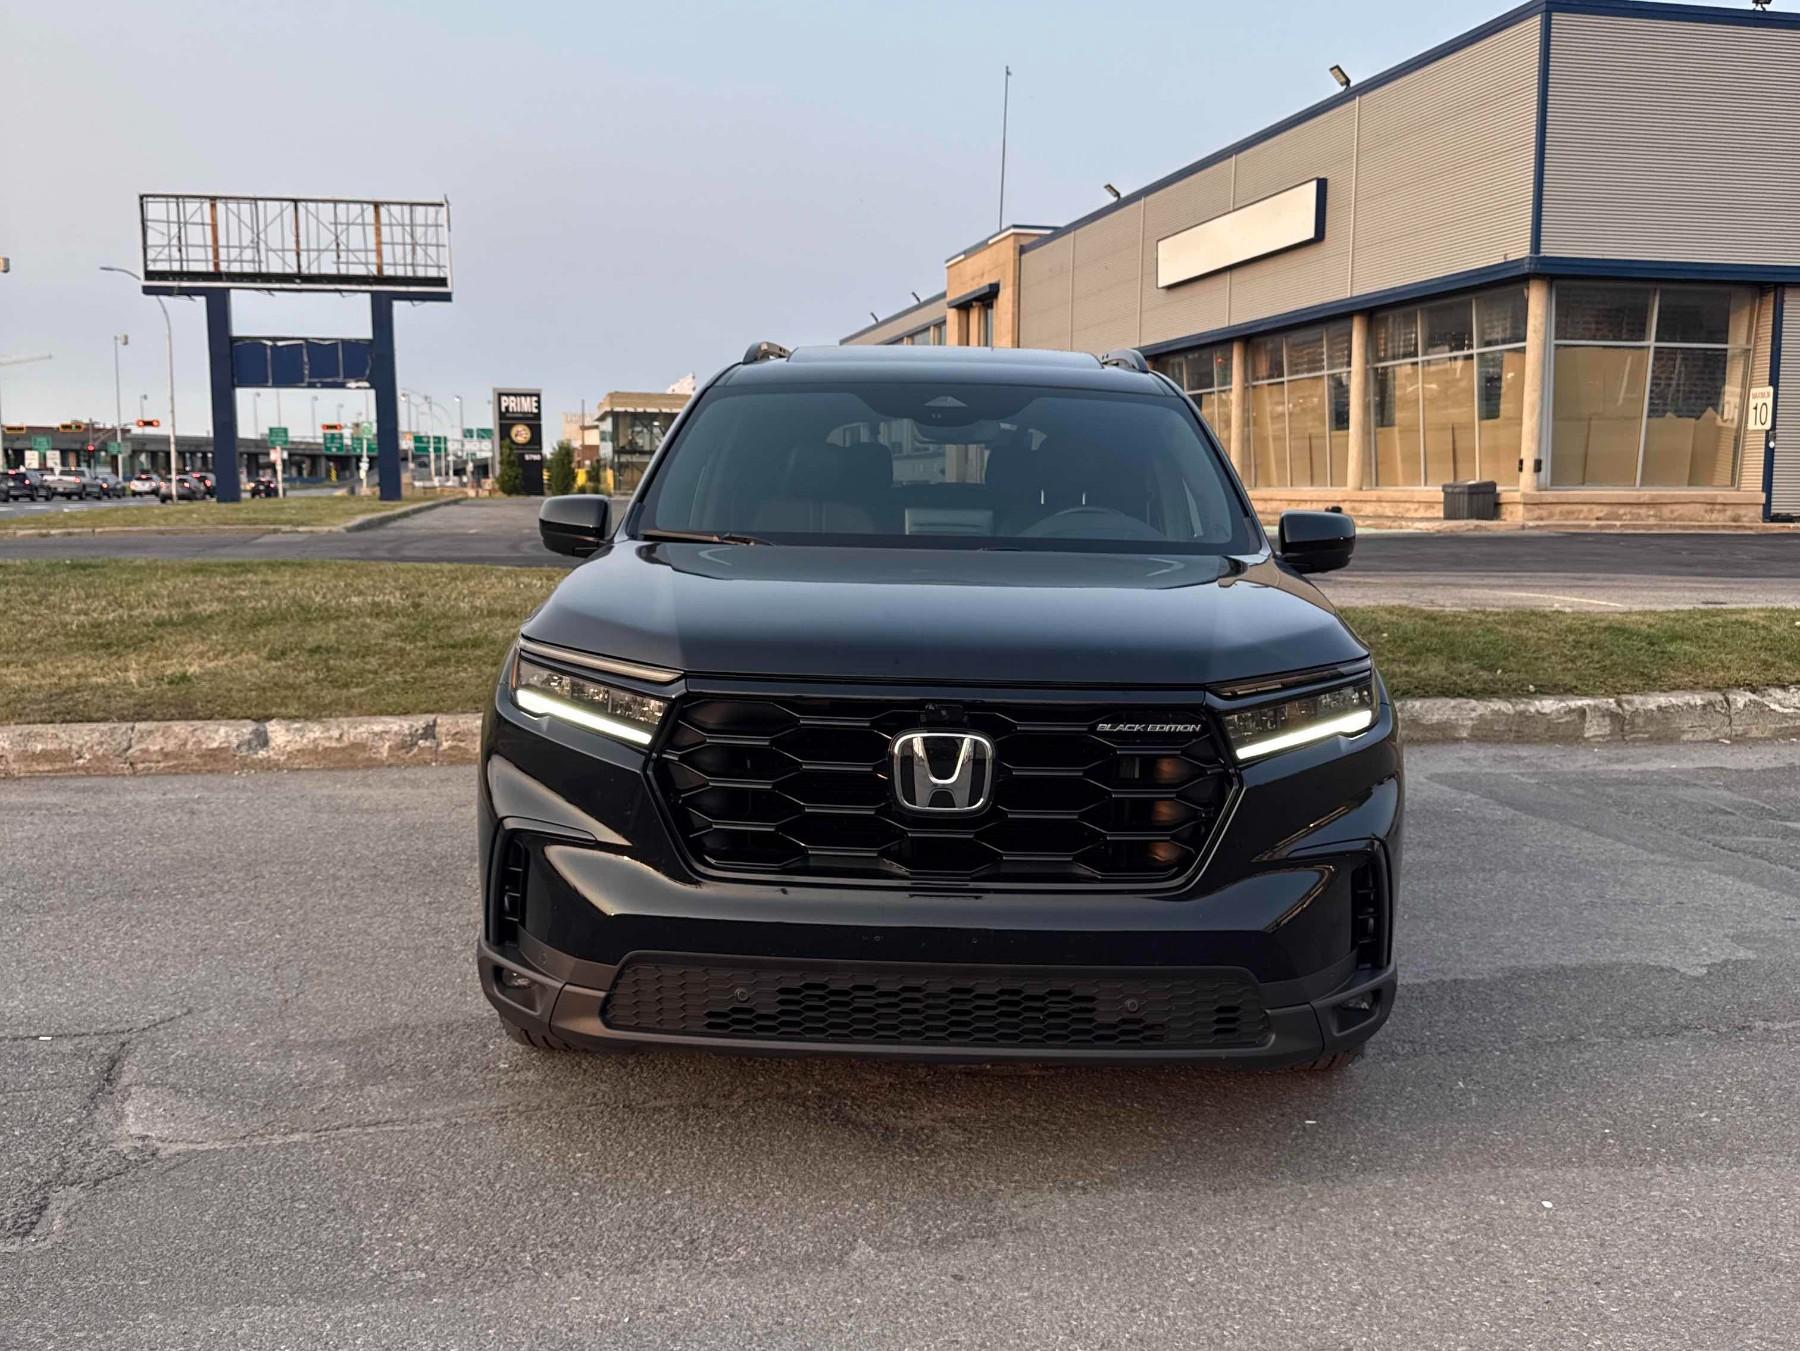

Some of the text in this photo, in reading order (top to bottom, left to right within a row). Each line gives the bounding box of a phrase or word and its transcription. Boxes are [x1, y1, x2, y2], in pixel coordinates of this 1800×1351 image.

[501, 395, 539, 413] PRIME
[1752, 402, 1768, 426] 10
[1096, 723, 1201, 732] BLACK EDITION
